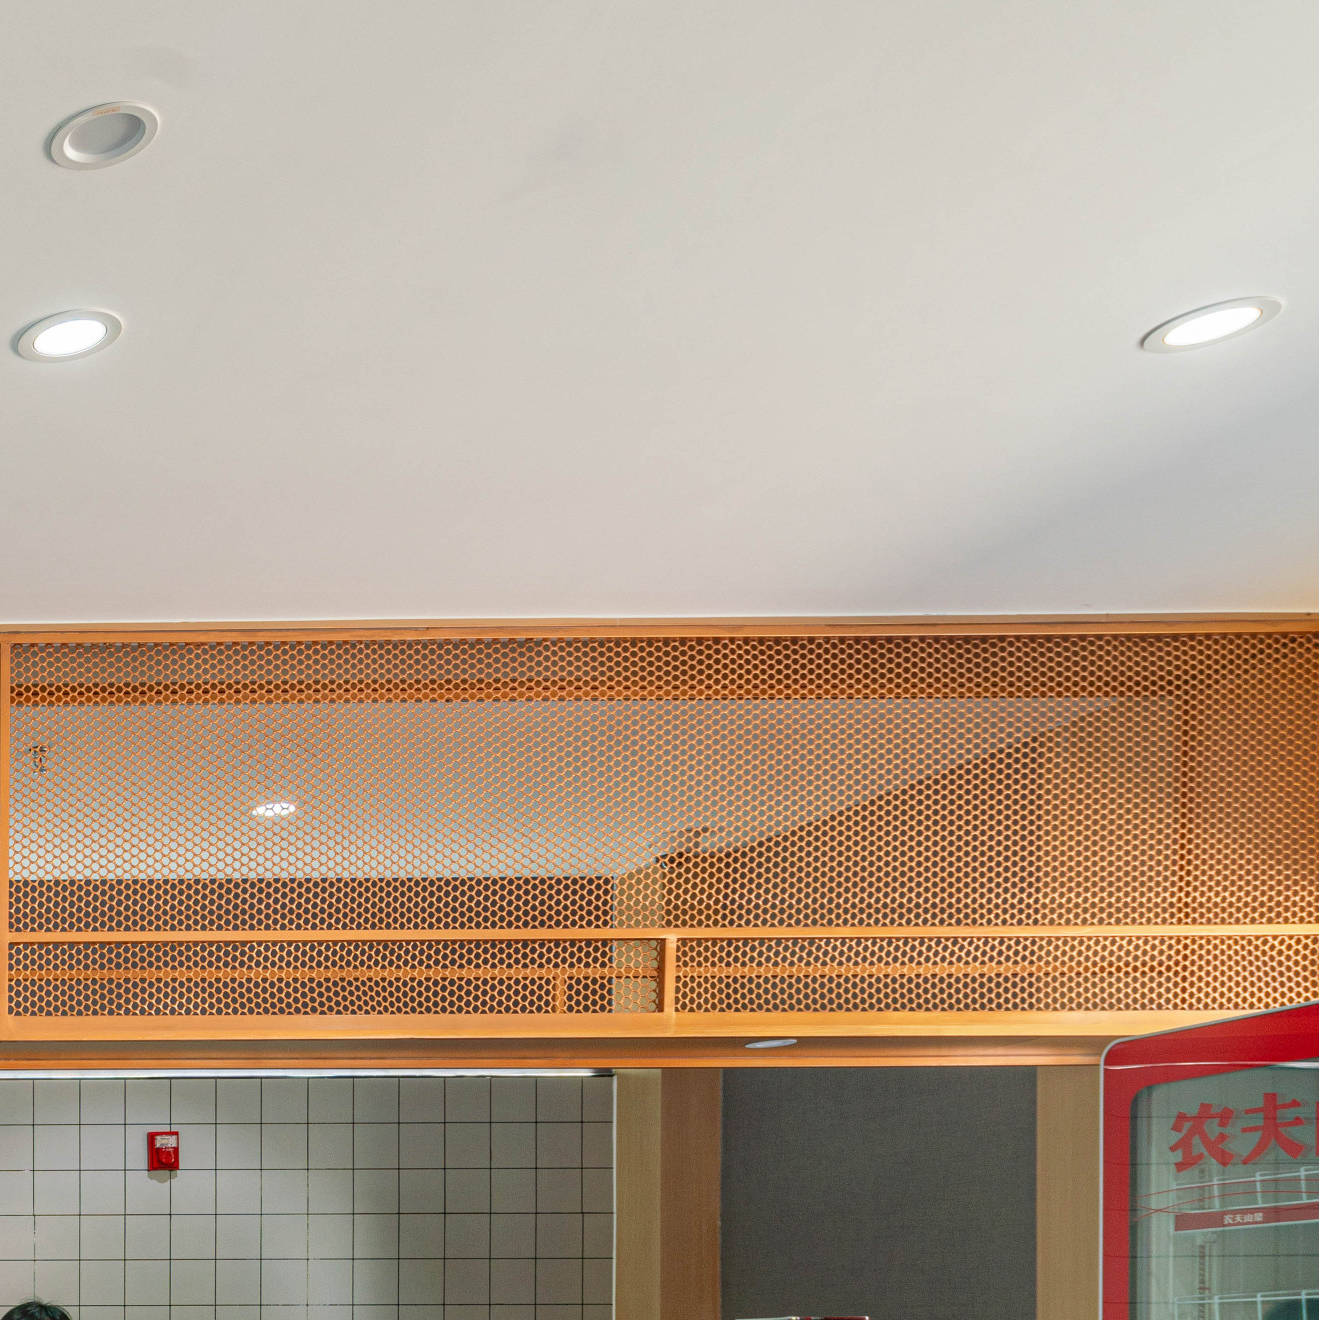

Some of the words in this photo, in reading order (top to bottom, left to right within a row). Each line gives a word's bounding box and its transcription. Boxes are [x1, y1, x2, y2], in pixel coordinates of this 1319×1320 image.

[1169, 1092, 1319, 1173] 农夫
[1222, 1212, 1264, 1225] 农夫山泉
